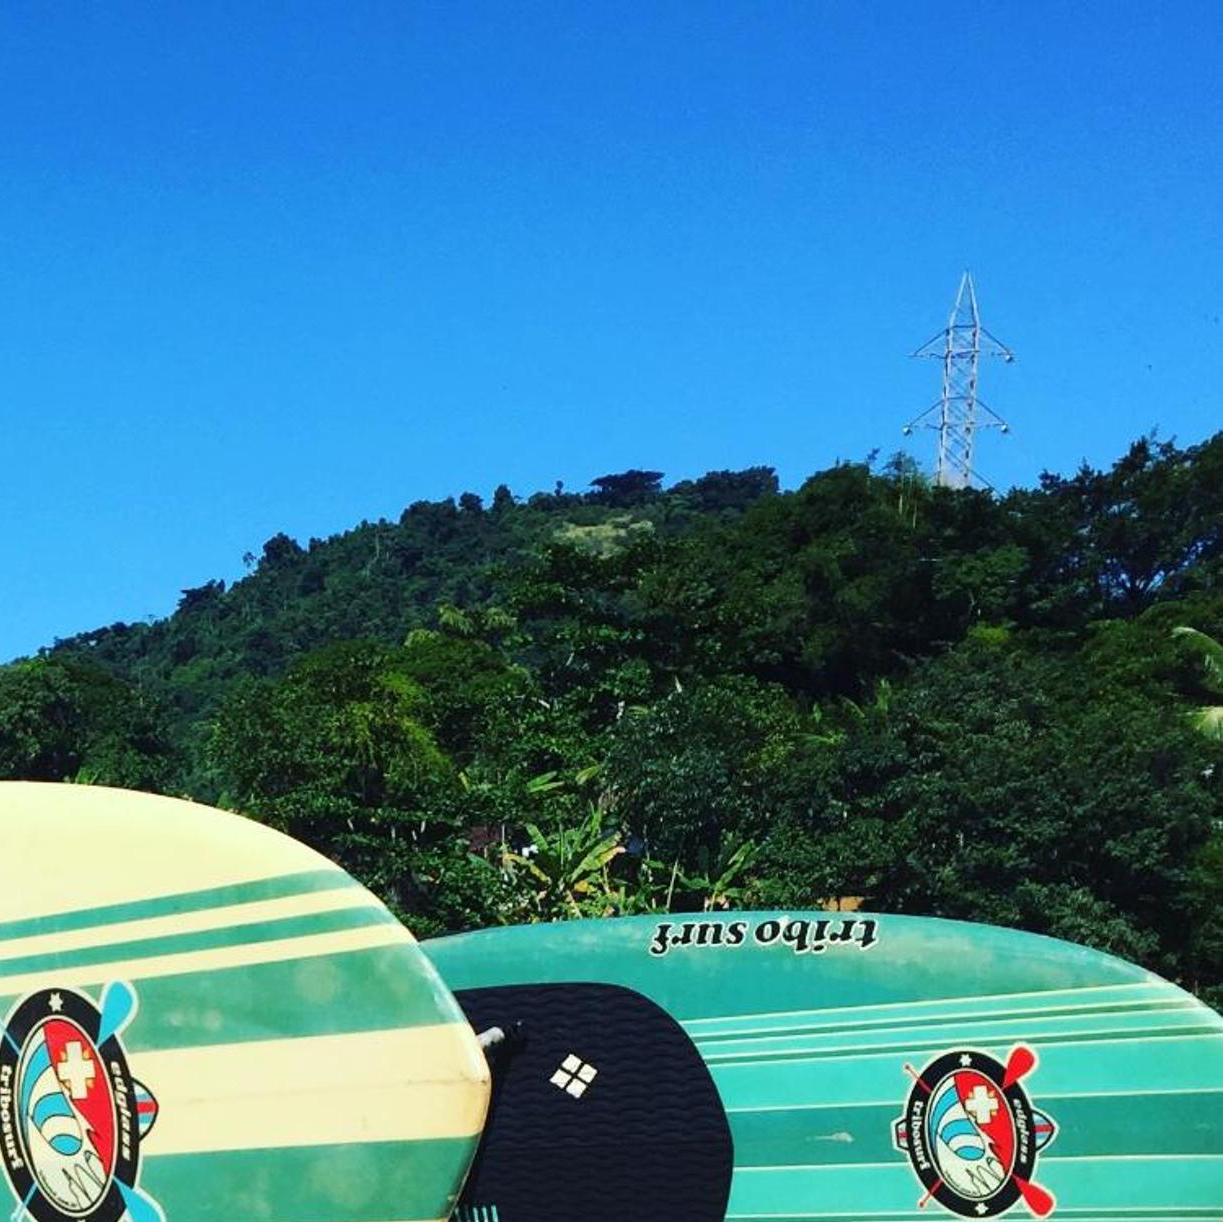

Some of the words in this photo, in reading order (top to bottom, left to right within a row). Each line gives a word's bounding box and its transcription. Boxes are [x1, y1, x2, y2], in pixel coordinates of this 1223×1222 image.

[650, 920, 747, 955] surf
[754, 918, 877, 953] tribo
[0, 1064, 25, 1170] tribosurf
[911, 1100, 930, 1171] tribosurf
